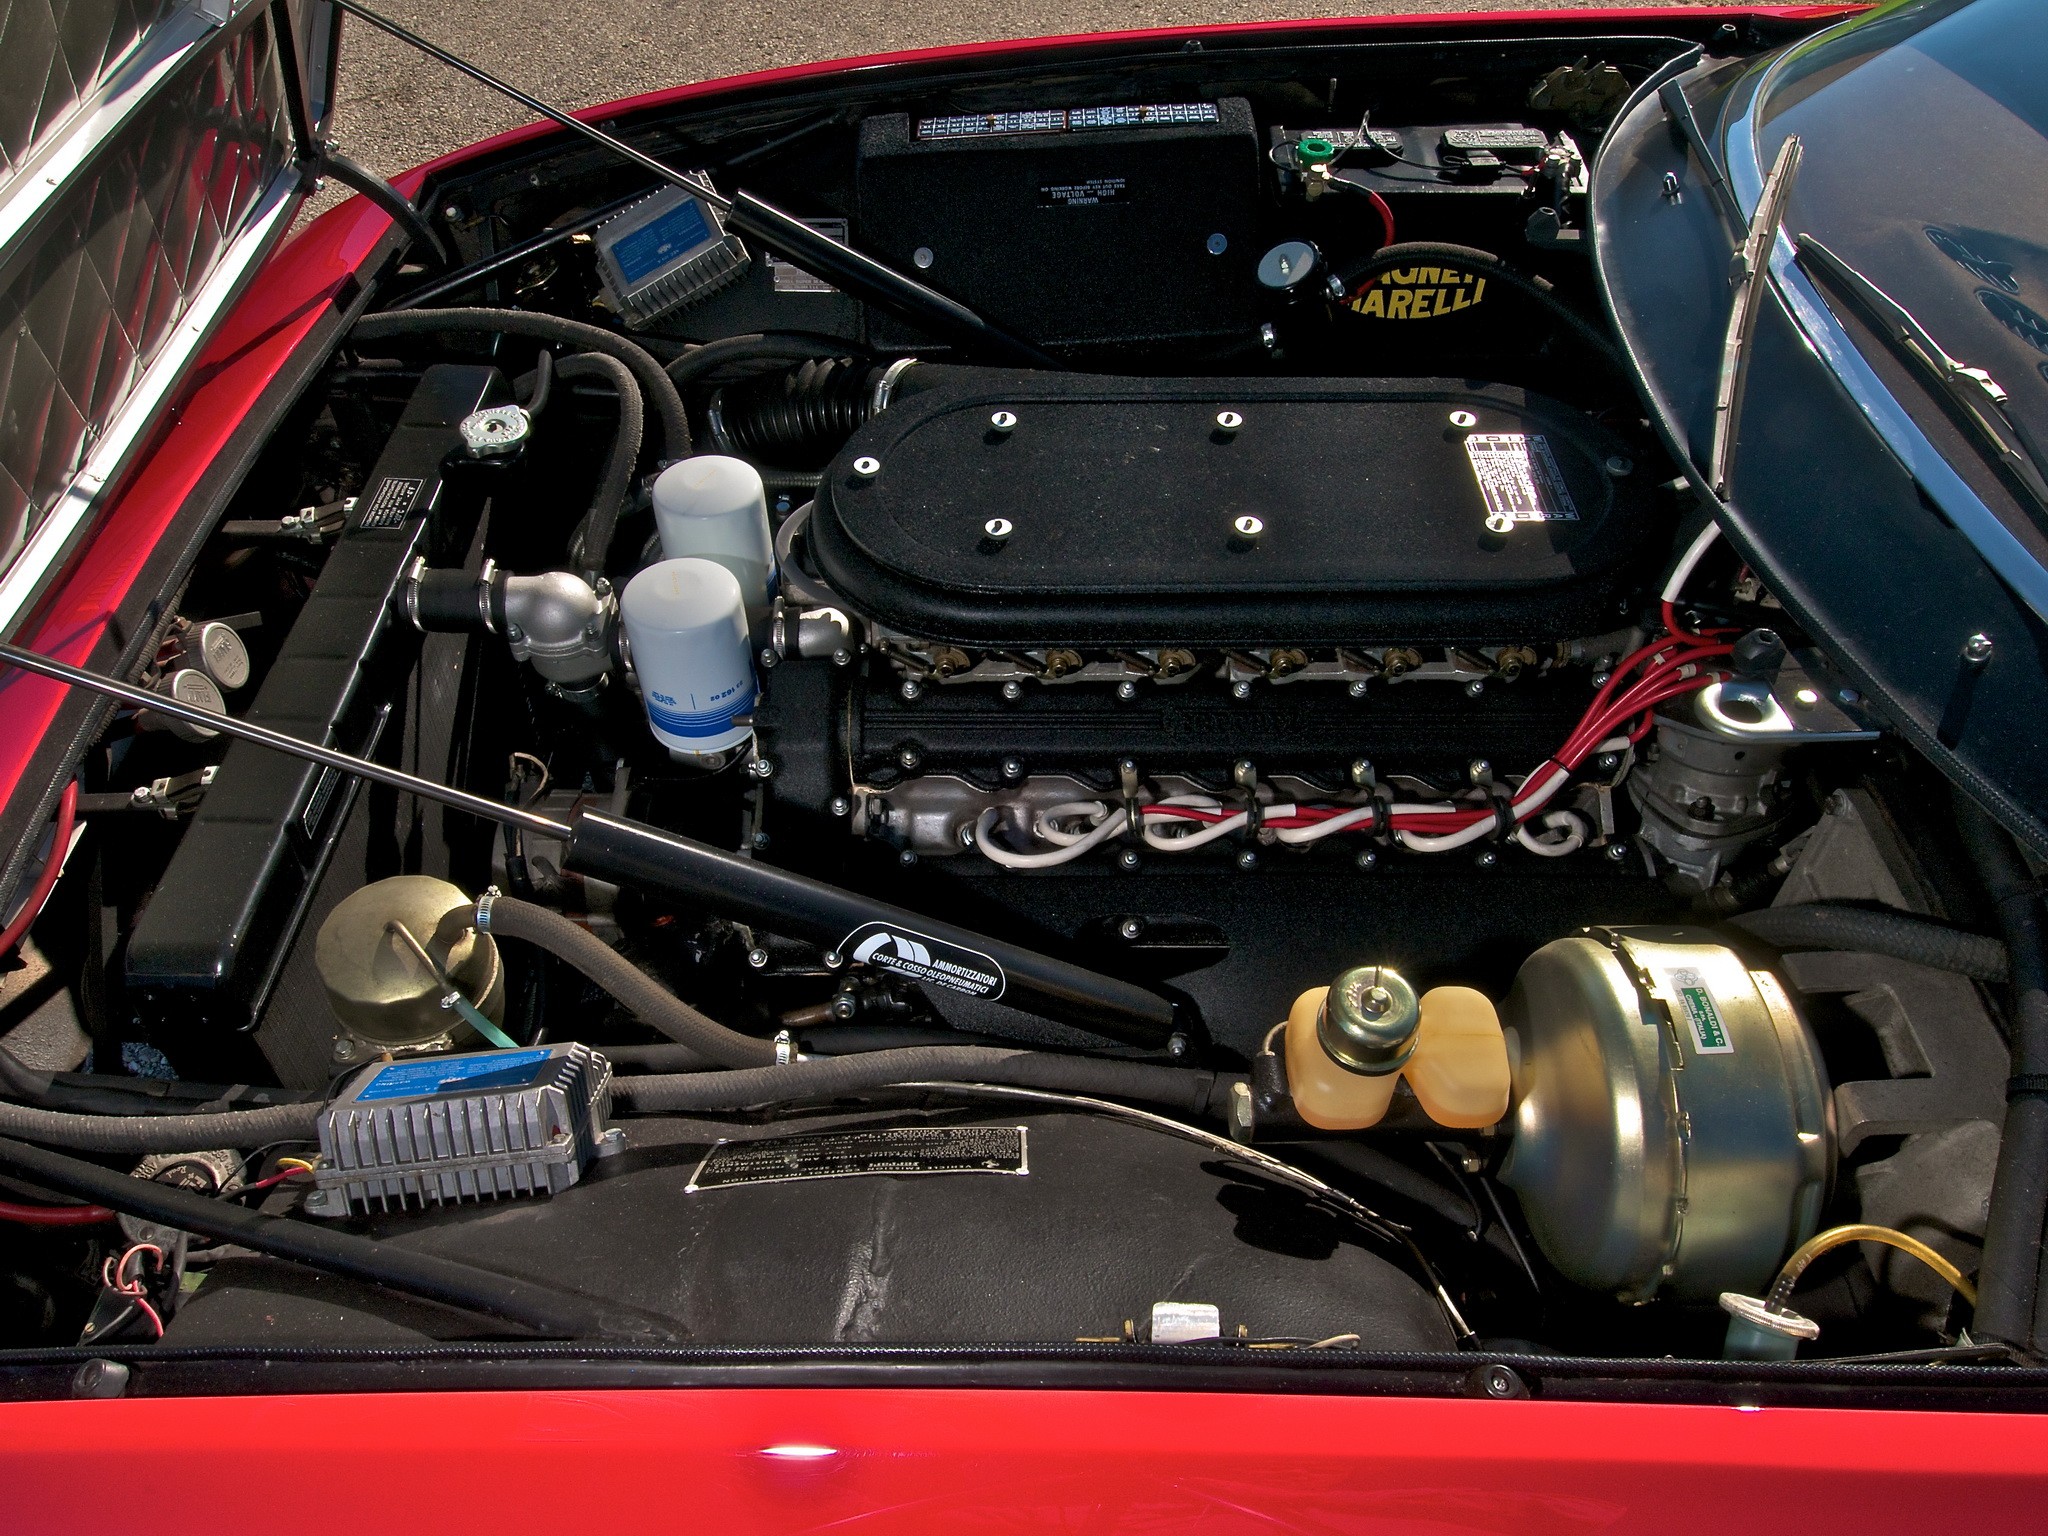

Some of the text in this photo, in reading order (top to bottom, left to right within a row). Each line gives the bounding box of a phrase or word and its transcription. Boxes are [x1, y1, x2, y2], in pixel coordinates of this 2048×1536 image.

[1052, 189, 1115, 199] HIGH VOLTAGE
[1067, 197, 1099, 205] WARNING
[710, 694, 720, 702] 02
[721, 687, 735, 698] 162
[872, 952, 897, 966] CORTE
[902, 962, 927, 975] COSSO
[926, 969, 990, 994] OLEOPNEUMATICI
[931, 958, 998, 987] AMMORTIZZATORI
[1685, 994, 1698, 1015] CREMA
[1694, 1017, 1708, 1040] (ITALIA)
[1696, 988, 1703, 996] D.
[1700, 996, 1719, 1029] BONALDI
[1715, 1038, 1724, 1047] C.
[808, 1168, 860, 1176] CONTROL
[722, 1172, 802, 1184] INFORMATION
